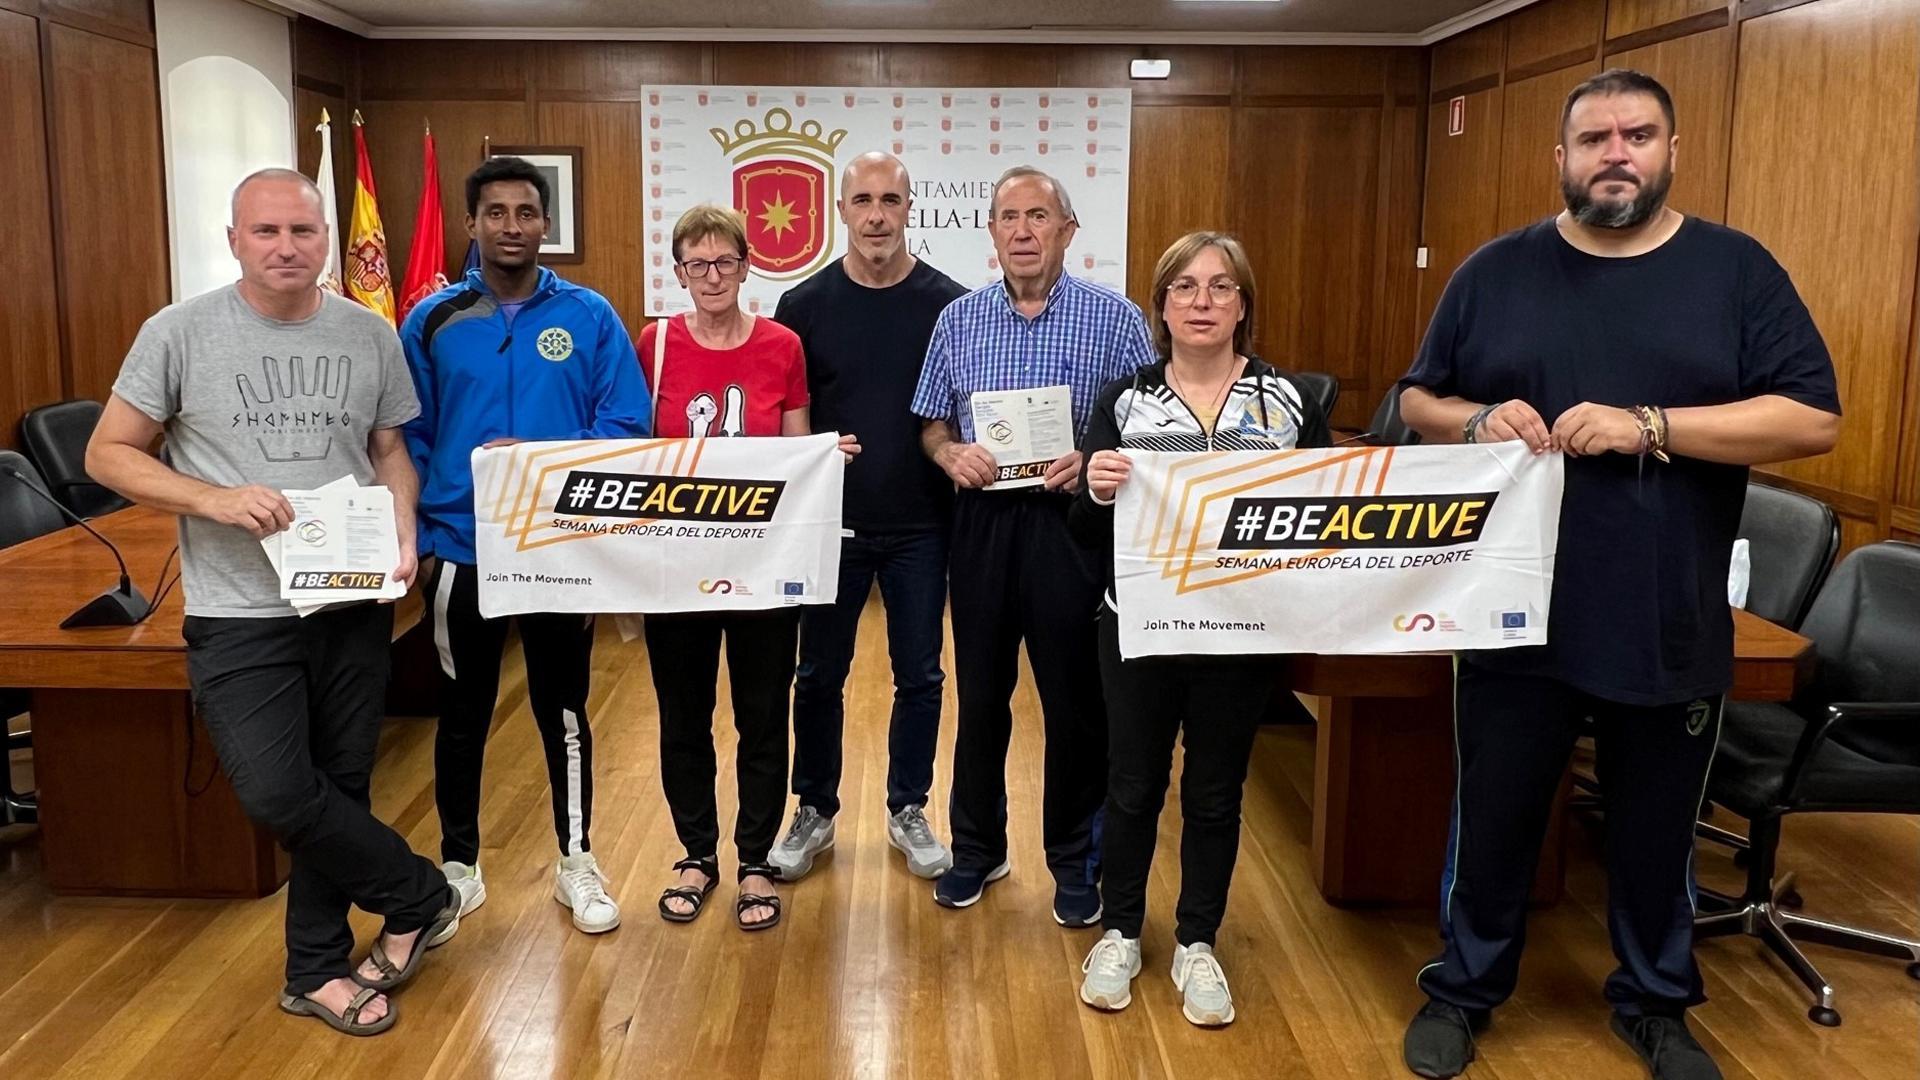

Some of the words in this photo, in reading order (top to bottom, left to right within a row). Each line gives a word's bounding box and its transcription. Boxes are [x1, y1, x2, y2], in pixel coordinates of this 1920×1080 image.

[909, 180, 995, 200] NTAMIE
[568, 478, 775, 516] #BEACTIVE
[551, 518, 607, 534] SEMANA
[609, 523, 673, 537] EUROPEA
[675, 527, 701, 538] DEL
[703, 527, 767, 539] DEPORTE
[1234, 500, 1486, 541] #BEACTIVE
[1215, 556, 1282, 570] SEMANA
[1285, 556, 1361, 570] EUROPEA
[1365, 556, 1396, 569] DEL
[1400, 549, 1474, 568] DEPORTE
[294, 573, 382, 588] #BEACTIVE
[486, 573, 509, 582] Join
[511, 573, 532, 583] The
[534, 574, 593, 586] Movement
[1143, 620, 1169, 631] Join
[1172, 620, 1196, 631] The
[1199, 620, 1266, 632] Movement
